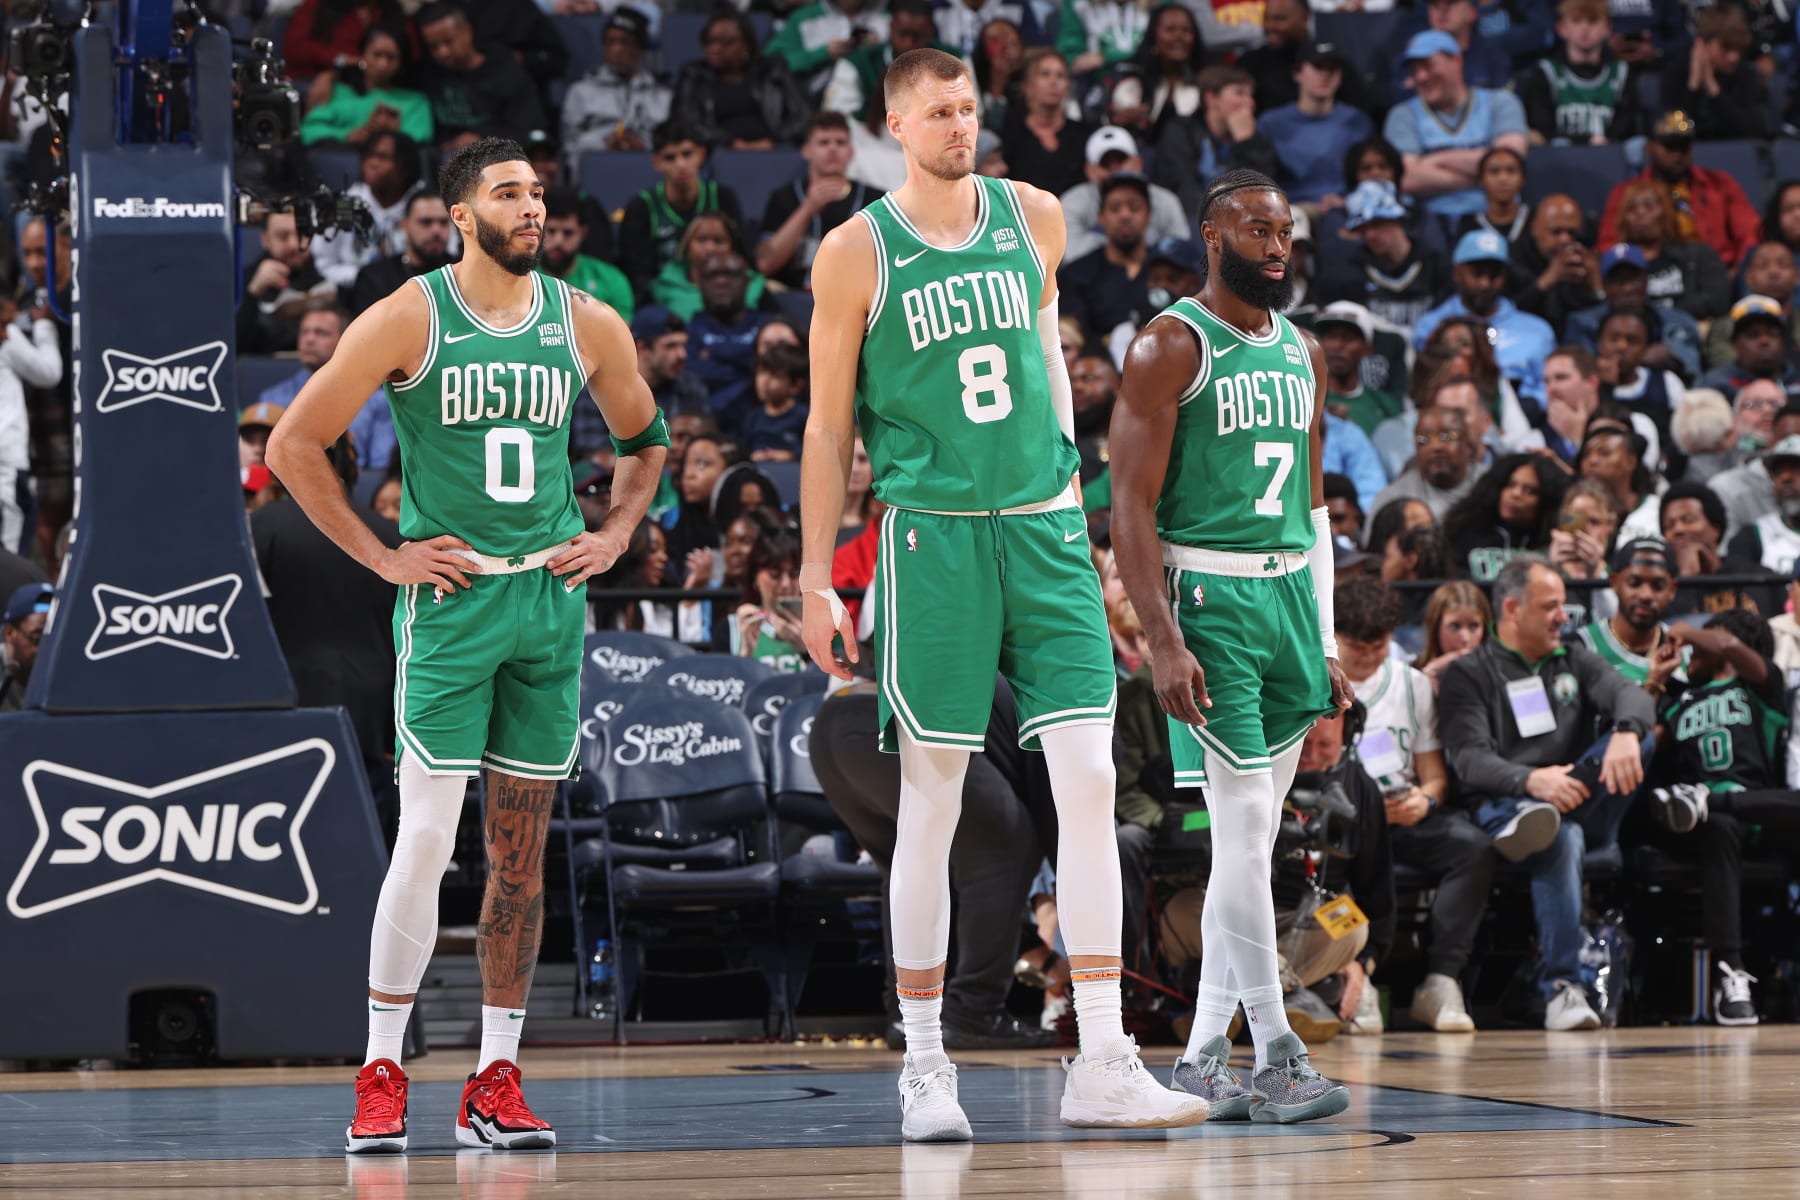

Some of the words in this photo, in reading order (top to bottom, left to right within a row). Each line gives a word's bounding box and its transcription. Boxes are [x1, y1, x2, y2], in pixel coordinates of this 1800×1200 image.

[94, 198, 224, 217] FedExForum
[991, 227, 1018, 243] VISTA
[995, 239, 1020, 253] PRINT
[538, 323, 564, 336] VISTA
[901, 270, 1031, 352] BOSTON
[540, 336, 566, 347] PRINT
[113, 366, 208, 392] SONIC
[441, 362, 572, 429] BOSTON
[958, 344, 1013, 424] 8
[1214, 370, 1315, 437] BOSTON
[484, 427, 536, 503] 0
[1254, 441, 1295, 516] 7
[105, 604, 220, 635] SONIC
[1677, 688, 1753, 742] CELTICS
[614, 721, 704, 766] Sissy's
[649, 744, 686, 766] Log
[685, 735, 743, 759] Cabin
[1698, 727, 1734, 772] 0
[48, 802, 287, 864] SONIC
